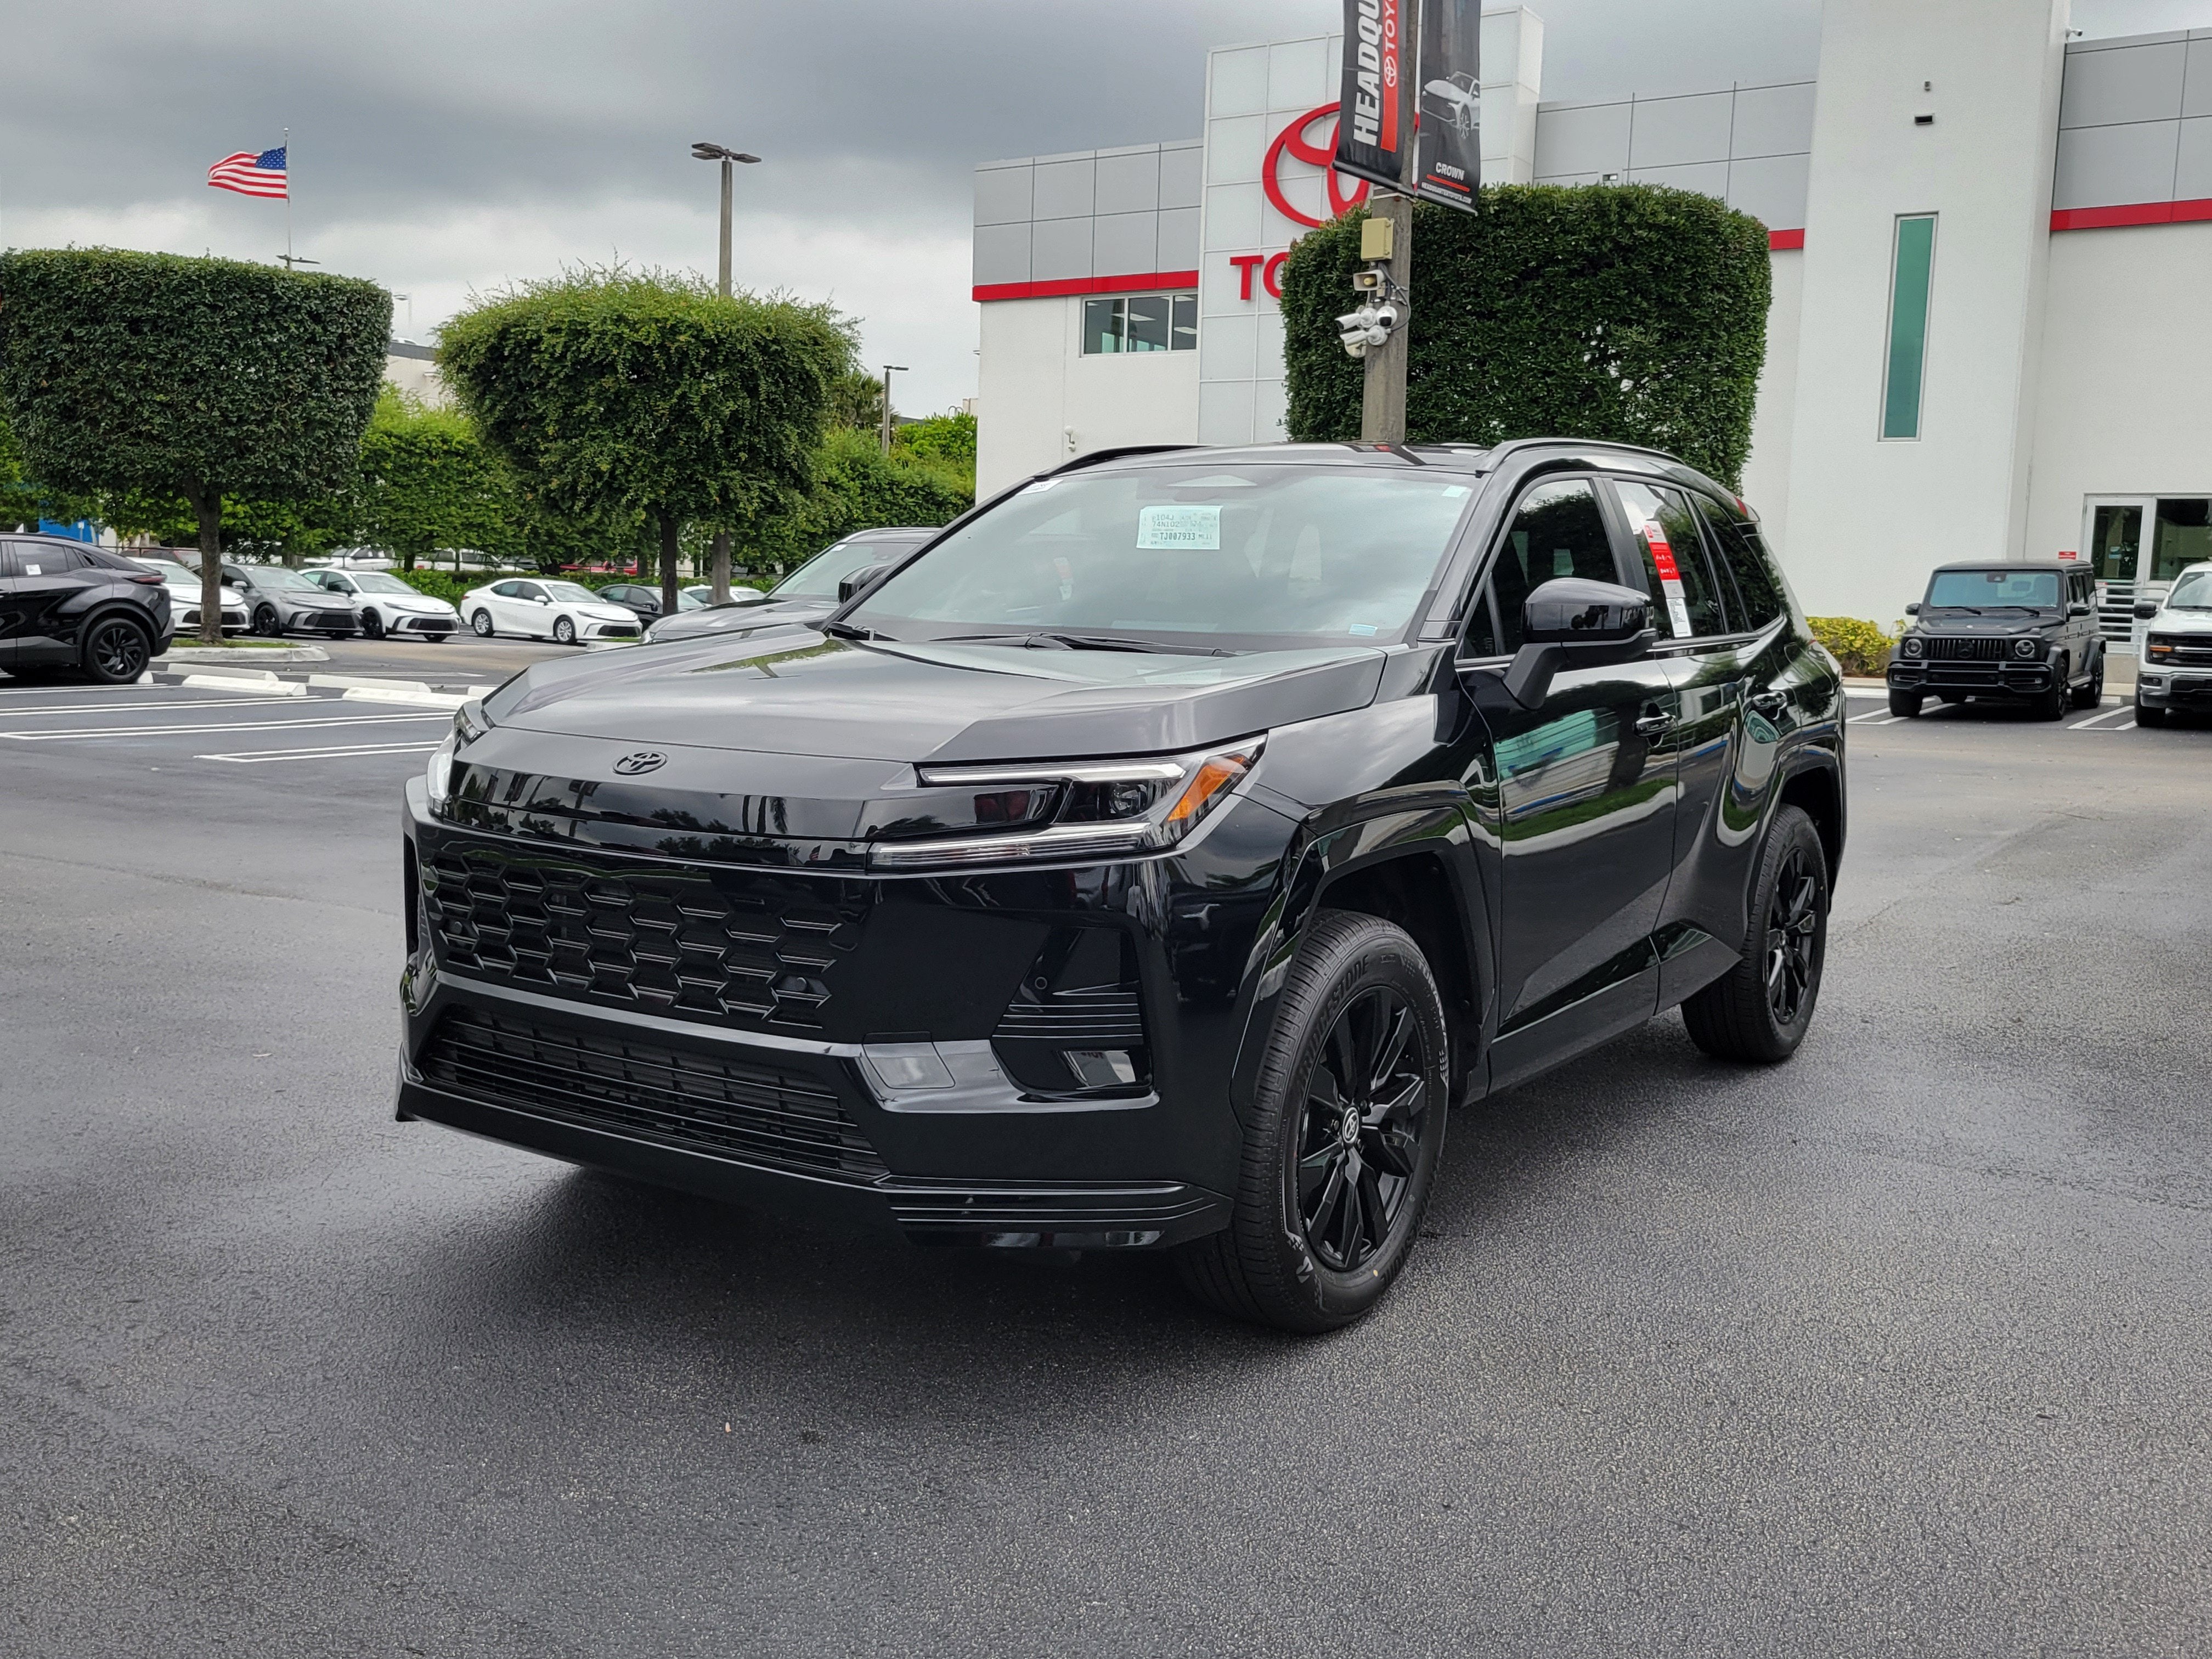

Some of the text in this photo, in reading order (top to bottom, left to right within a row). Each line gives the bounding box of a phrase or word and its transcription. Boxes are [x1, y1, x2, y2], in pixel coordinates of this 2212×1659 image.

[1385, 0, 1396, 52] TOY
[1436, 162, 1465, 181] CROWN
[1160, 532, 1195, 540] TJ007933
